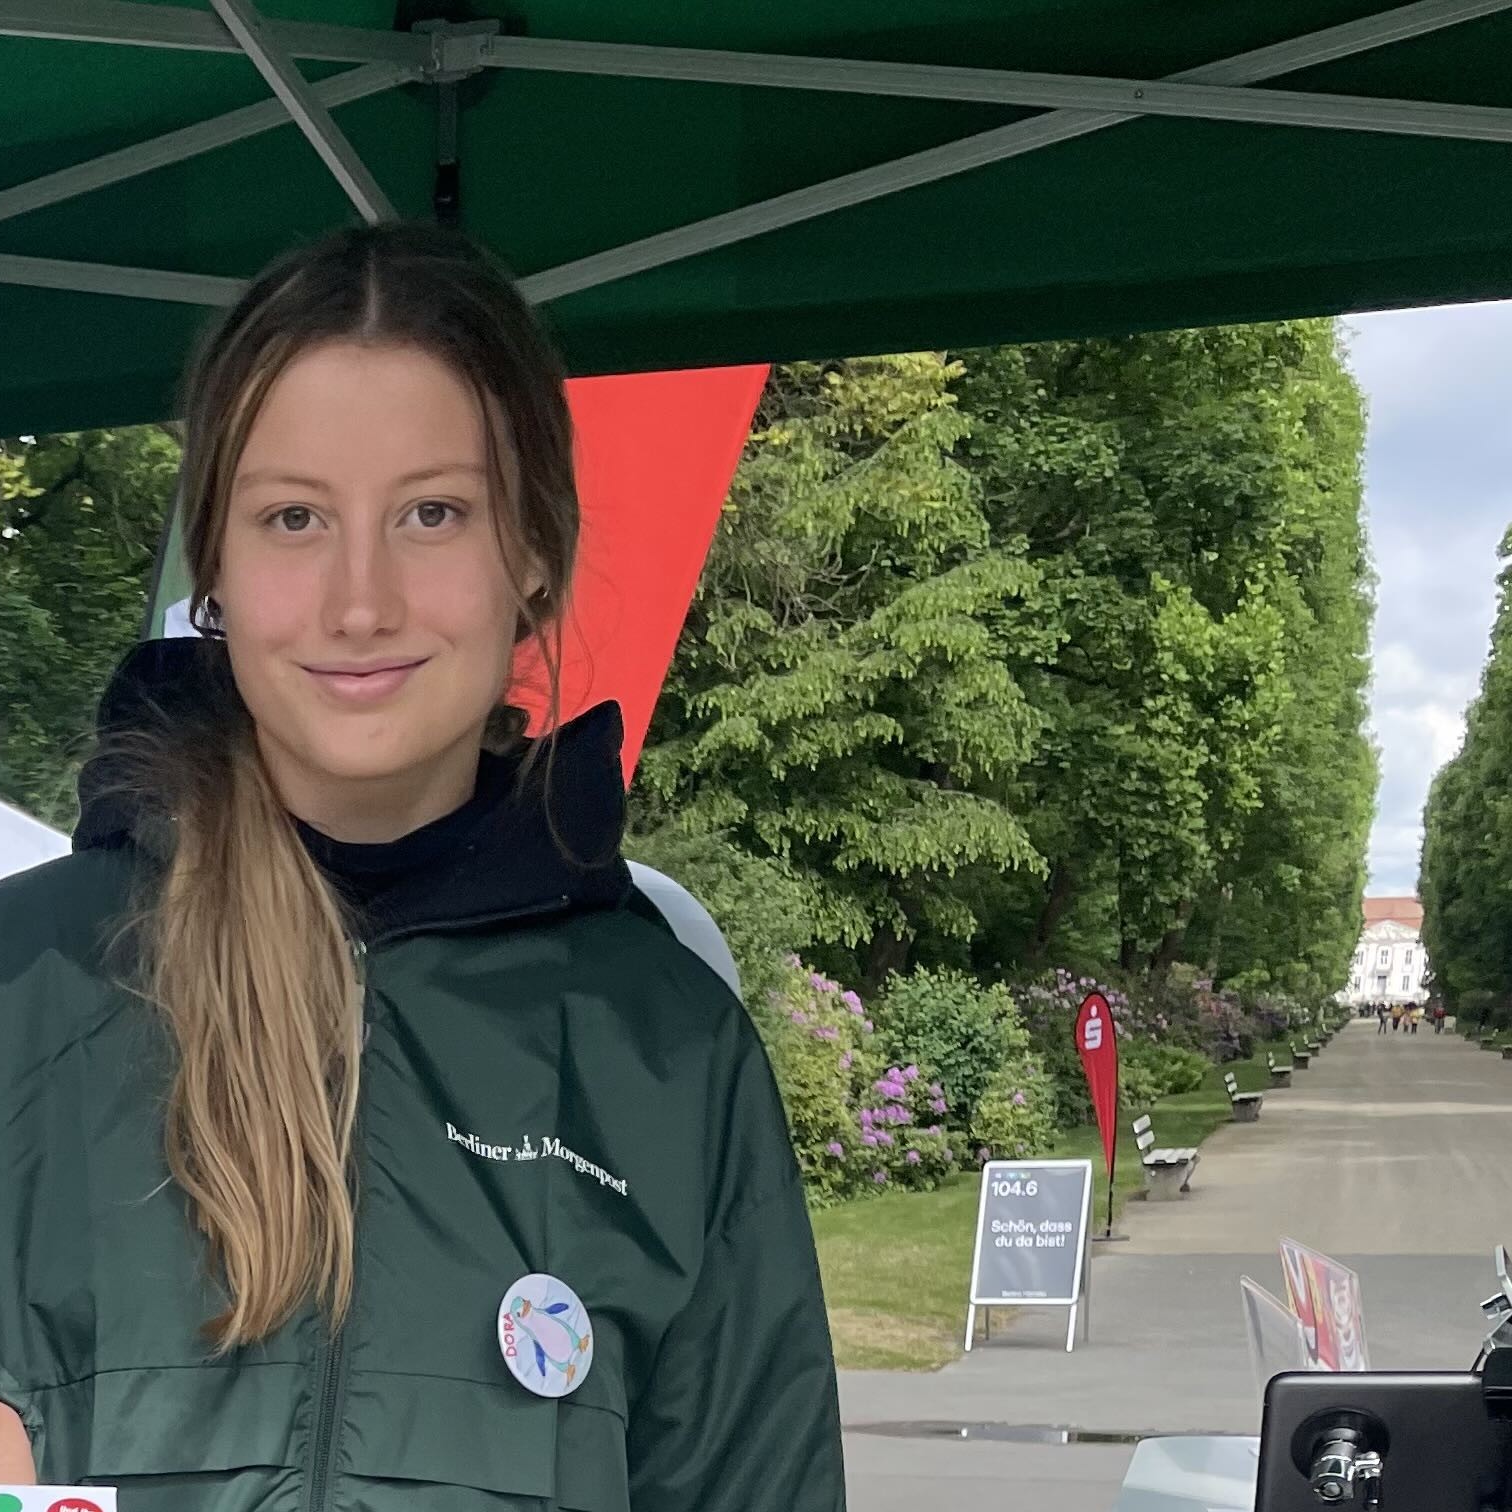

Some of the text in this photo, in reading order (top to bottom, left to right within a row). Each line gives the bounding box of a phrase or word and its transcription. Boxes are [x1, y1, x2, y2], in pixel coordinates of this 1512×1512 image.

[446, 1122, 628, 1196] Berliner Morgenpost
[991, 1180, 1038, 1196] 104.6
[991, 1219, 1073, 1234] Schön, dass
[995, 1234, 1065, 1247] du da bist!
[503, 1312, 517, 1357] DORA
